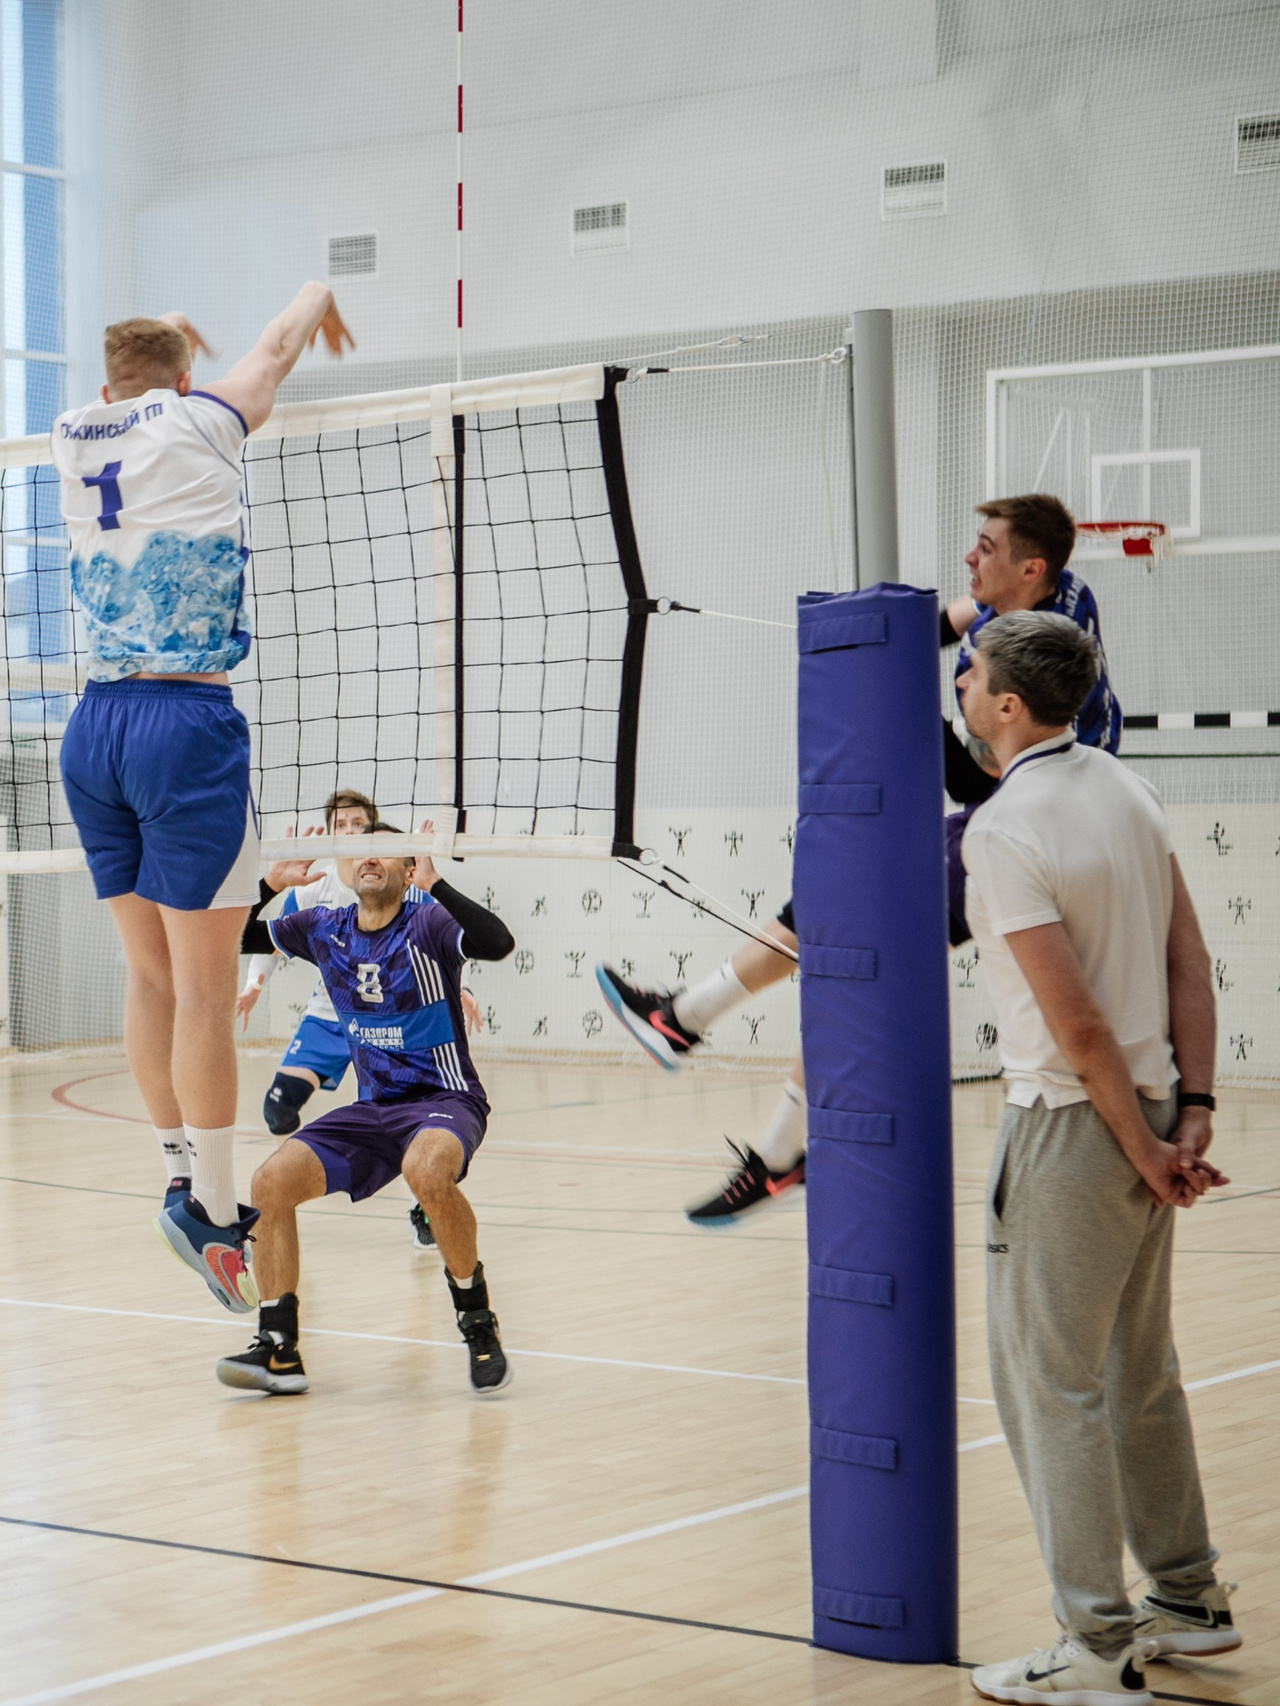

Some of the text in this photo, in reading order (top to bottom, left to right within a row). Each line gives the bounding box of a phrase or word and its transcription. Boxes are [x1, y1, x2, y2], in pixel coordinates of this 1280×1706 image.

[144, 402, 163, 422] ГП
[82, 459, 123, 531] 1
[357, 963, 384, 1003] 8
[360, 1026, 403, 1039] ГАЗПРОМ
[289, 1039, 302, 1055] 2
